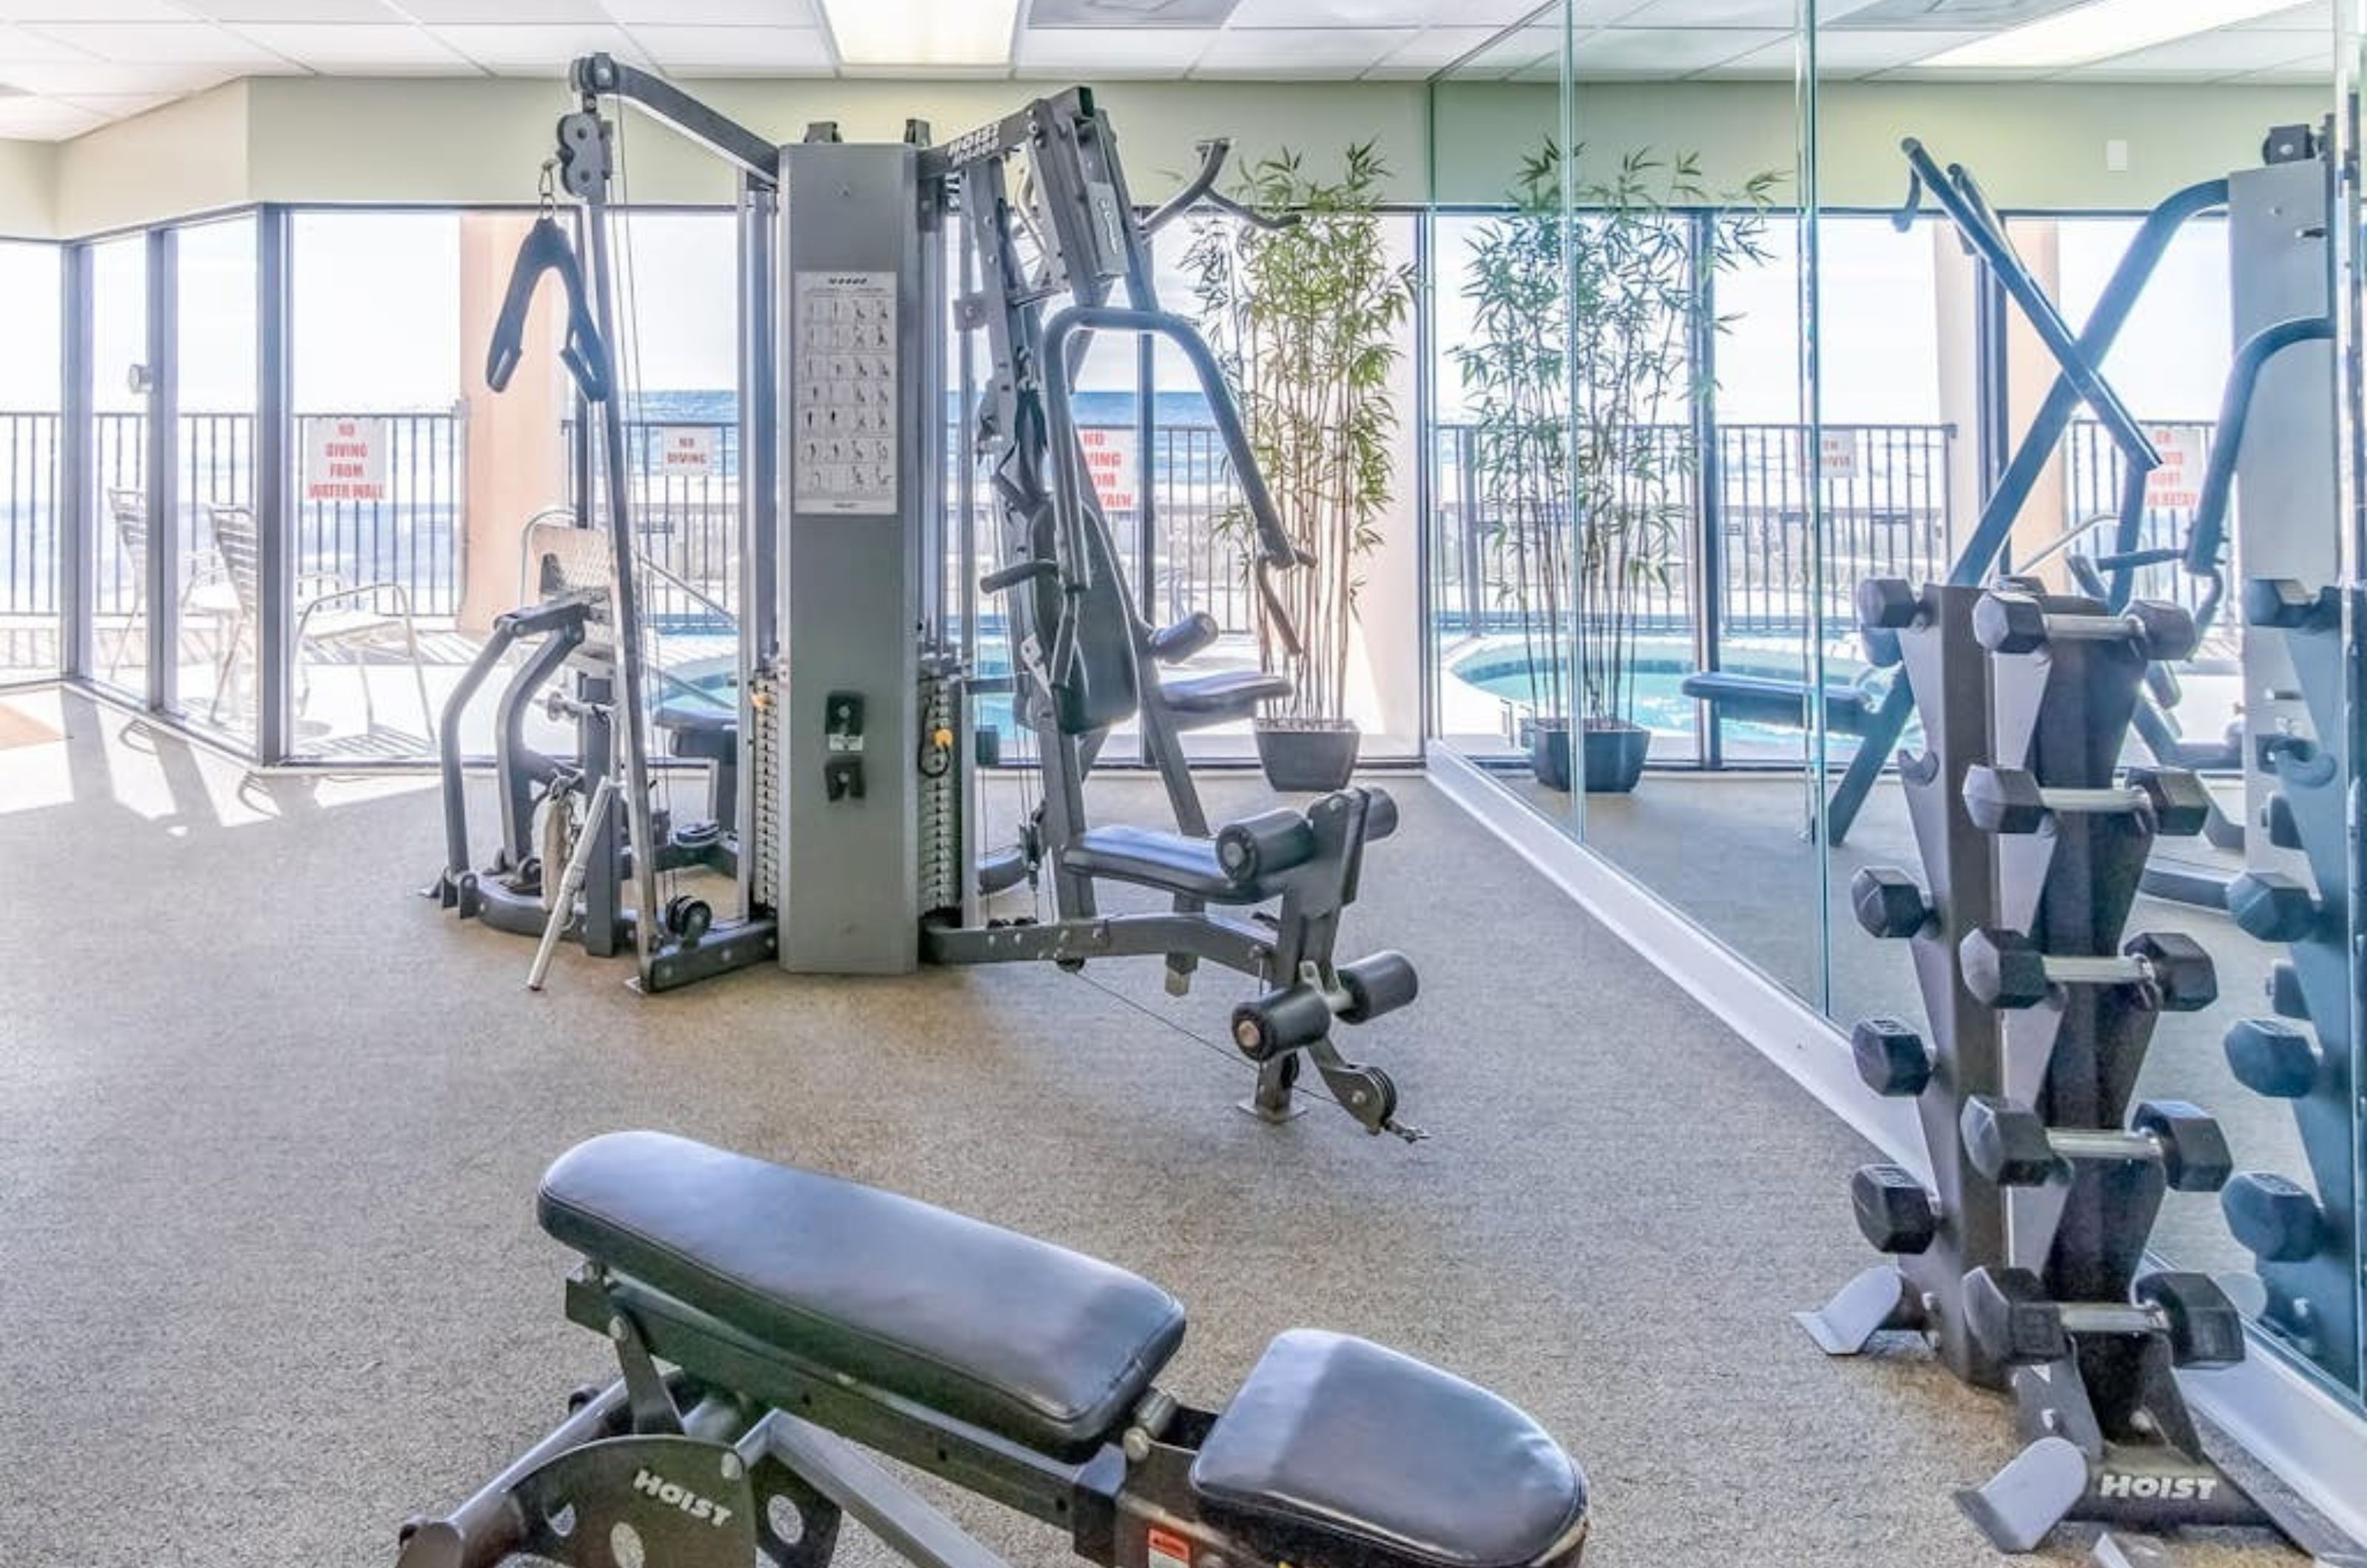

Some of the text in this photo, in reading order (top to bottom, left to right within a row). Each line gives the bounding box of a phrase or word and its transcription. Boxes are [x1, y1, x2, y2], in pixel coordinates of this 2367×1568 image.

[338, 423, 355, 437] NO
[679, 437, 695, 448] NO
[1083, 433, 1104, 445] NO
[325, 442, 368, 458] DIVING
[667, 451, 708, 464] DIVING
[1084, 451, 1121, 466] VING
[330, 462, 365, 478] FROM
[308, 483, 385, 499] WATER WALL
[2099, 1473, 2218, 1501] HOIST
[633, 1468, 732, 1527] HOIST
